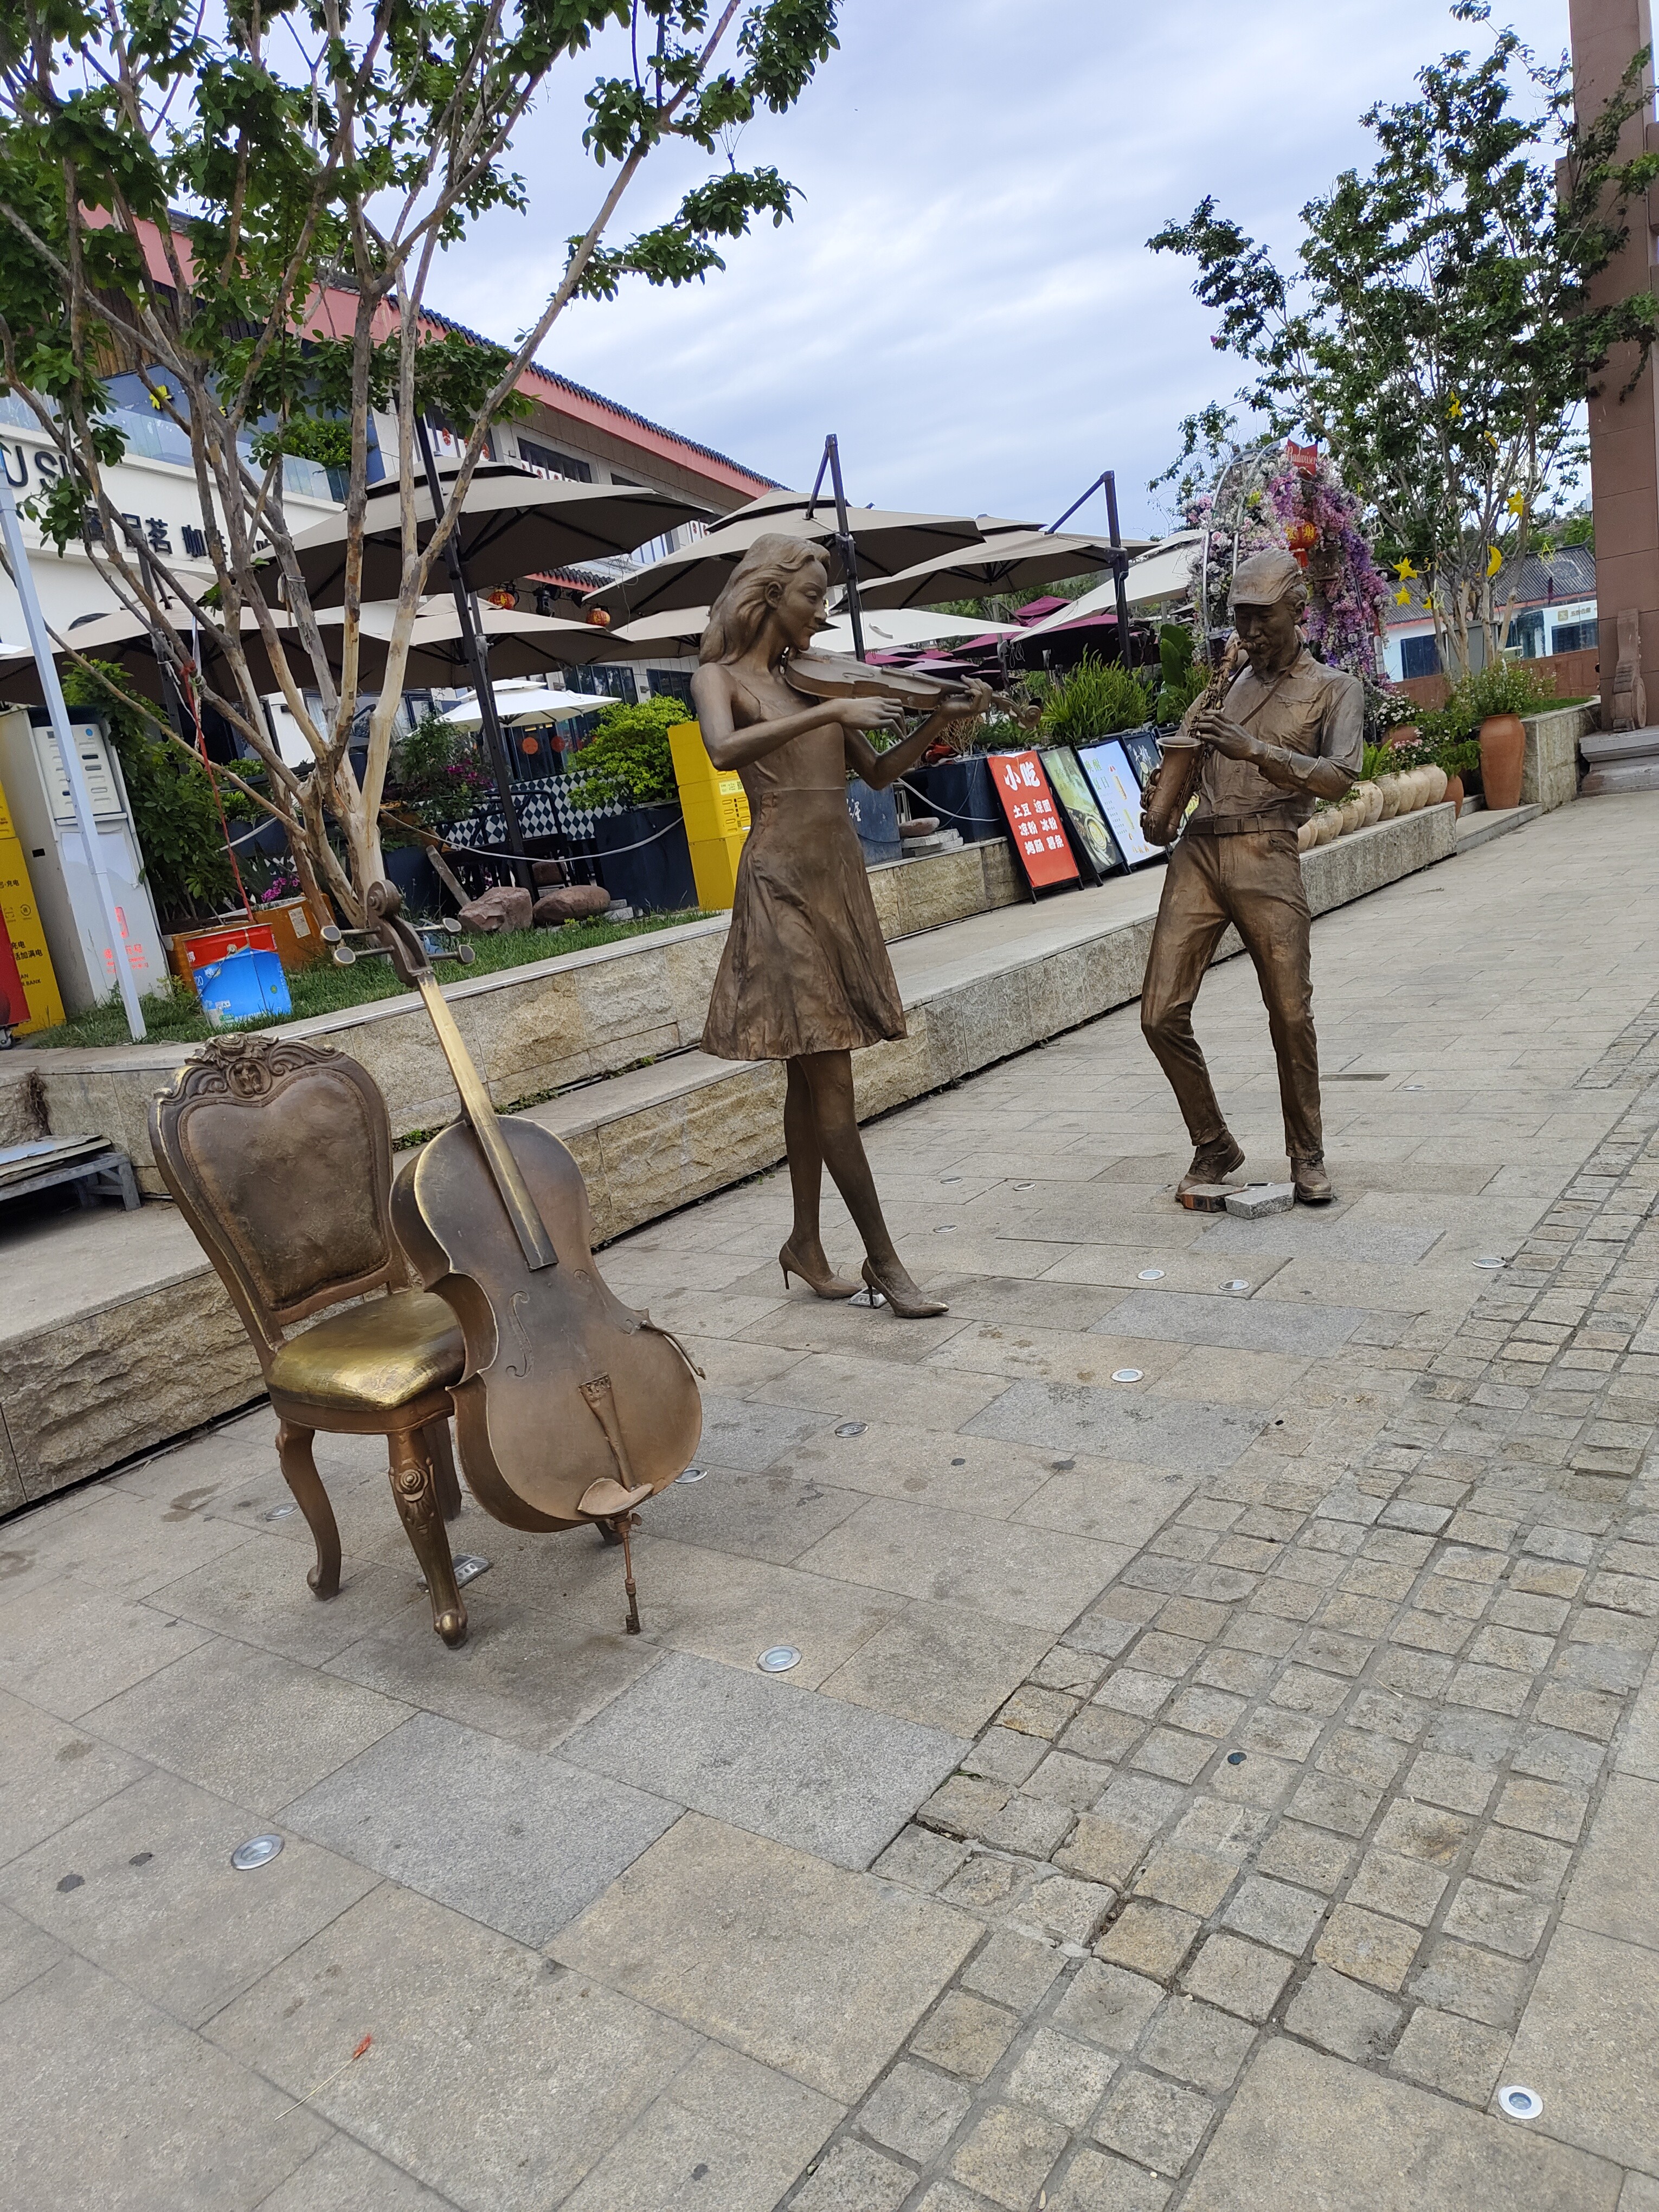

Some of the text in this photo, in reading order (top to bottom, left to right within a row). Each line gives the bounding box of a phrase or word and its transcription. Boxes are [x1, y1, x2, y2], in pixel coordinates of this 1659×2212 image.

[1286, 446, 1316, 465] Budweiser
[1003, 761, 1040, 791] 小吃
[1013, 802, 1032, 819] 土豆
[1018, 816, 1058, 837] 凉粉 冰粉
[1024, 834, 1064, 856] 烤肠 薯条
